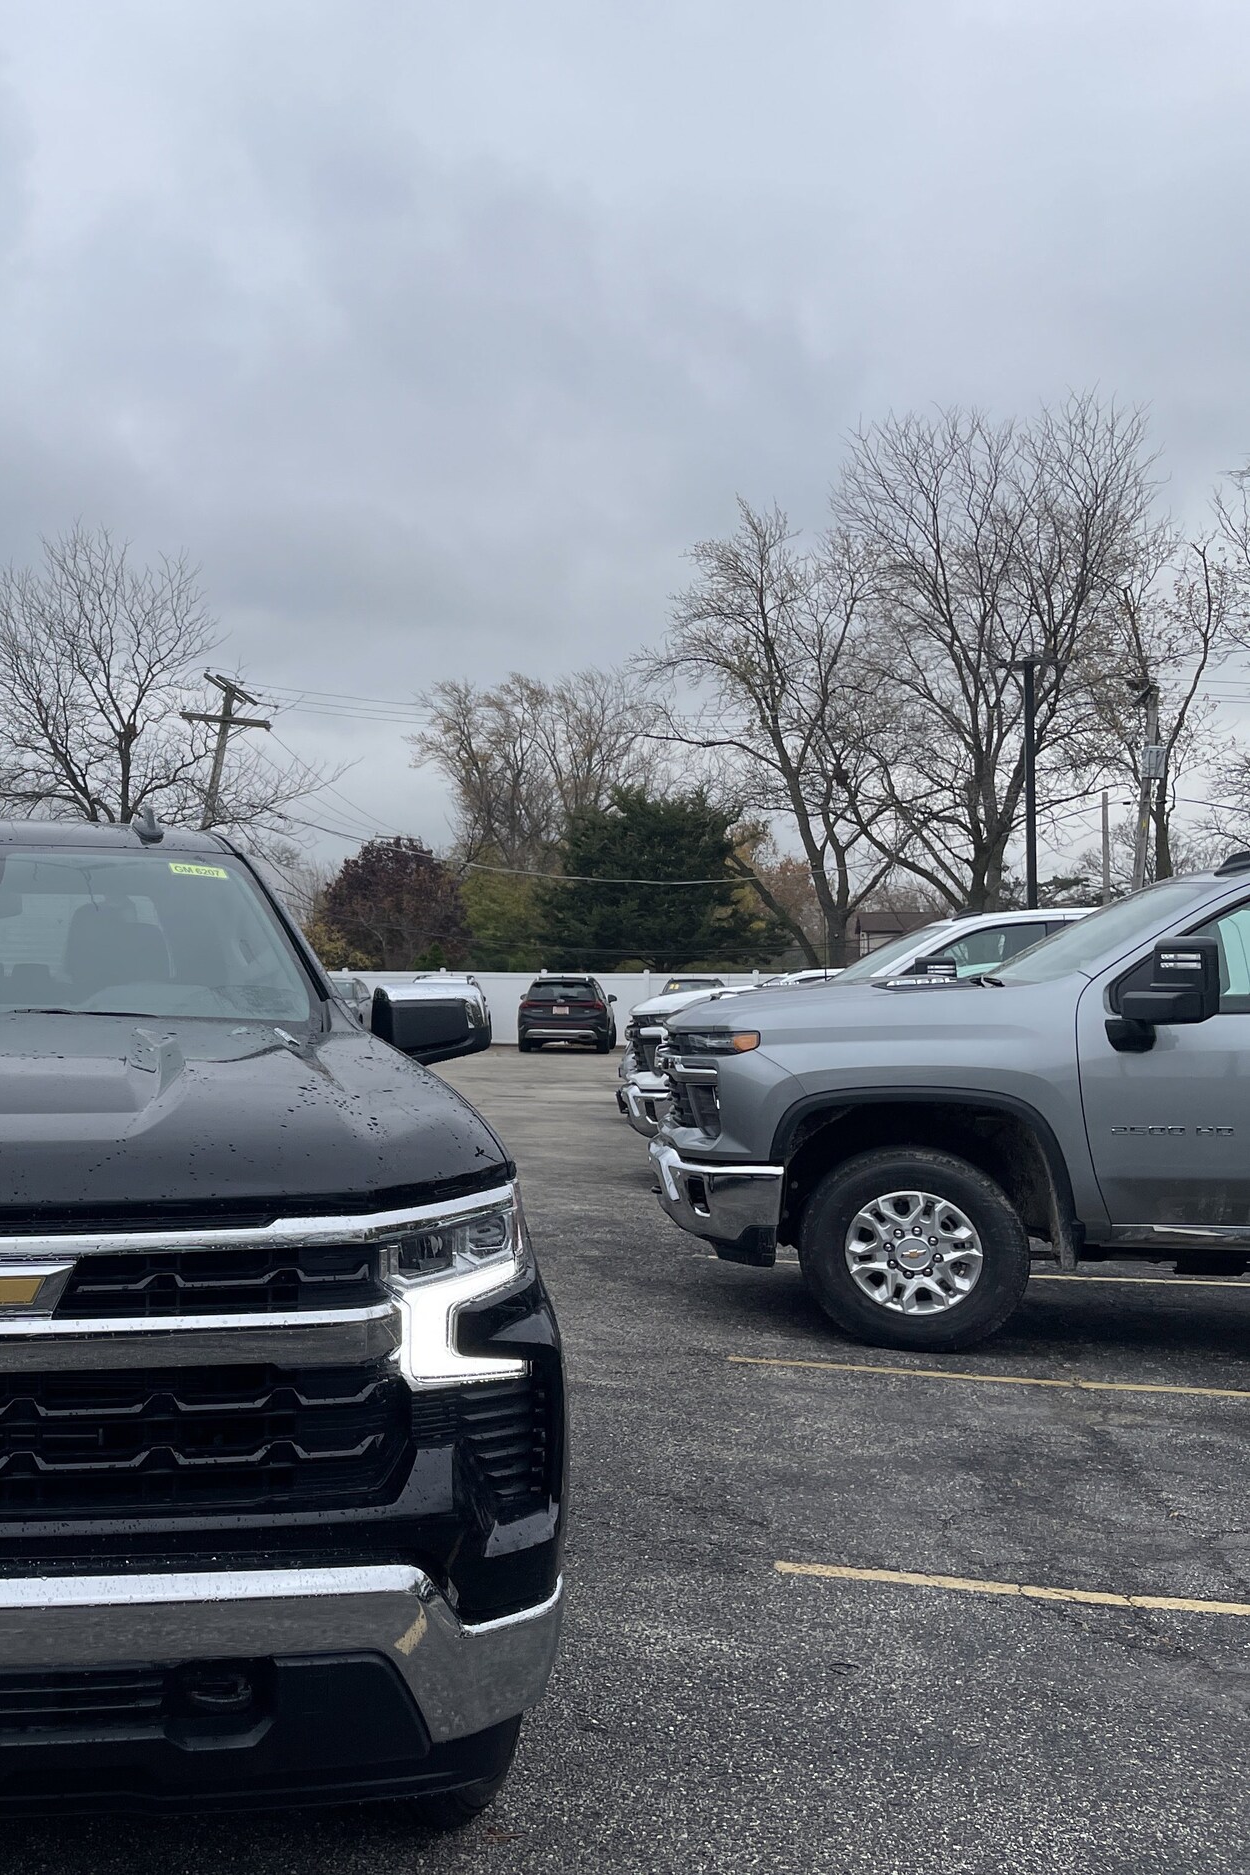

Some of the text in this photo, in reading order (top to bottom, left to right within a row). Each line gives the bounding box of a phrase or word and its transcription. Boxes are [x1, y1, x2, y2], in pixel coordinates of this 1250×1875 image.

[174, 865, 193, 874] GM
[1111, 1125, 1234, 1137] 2500 HD
